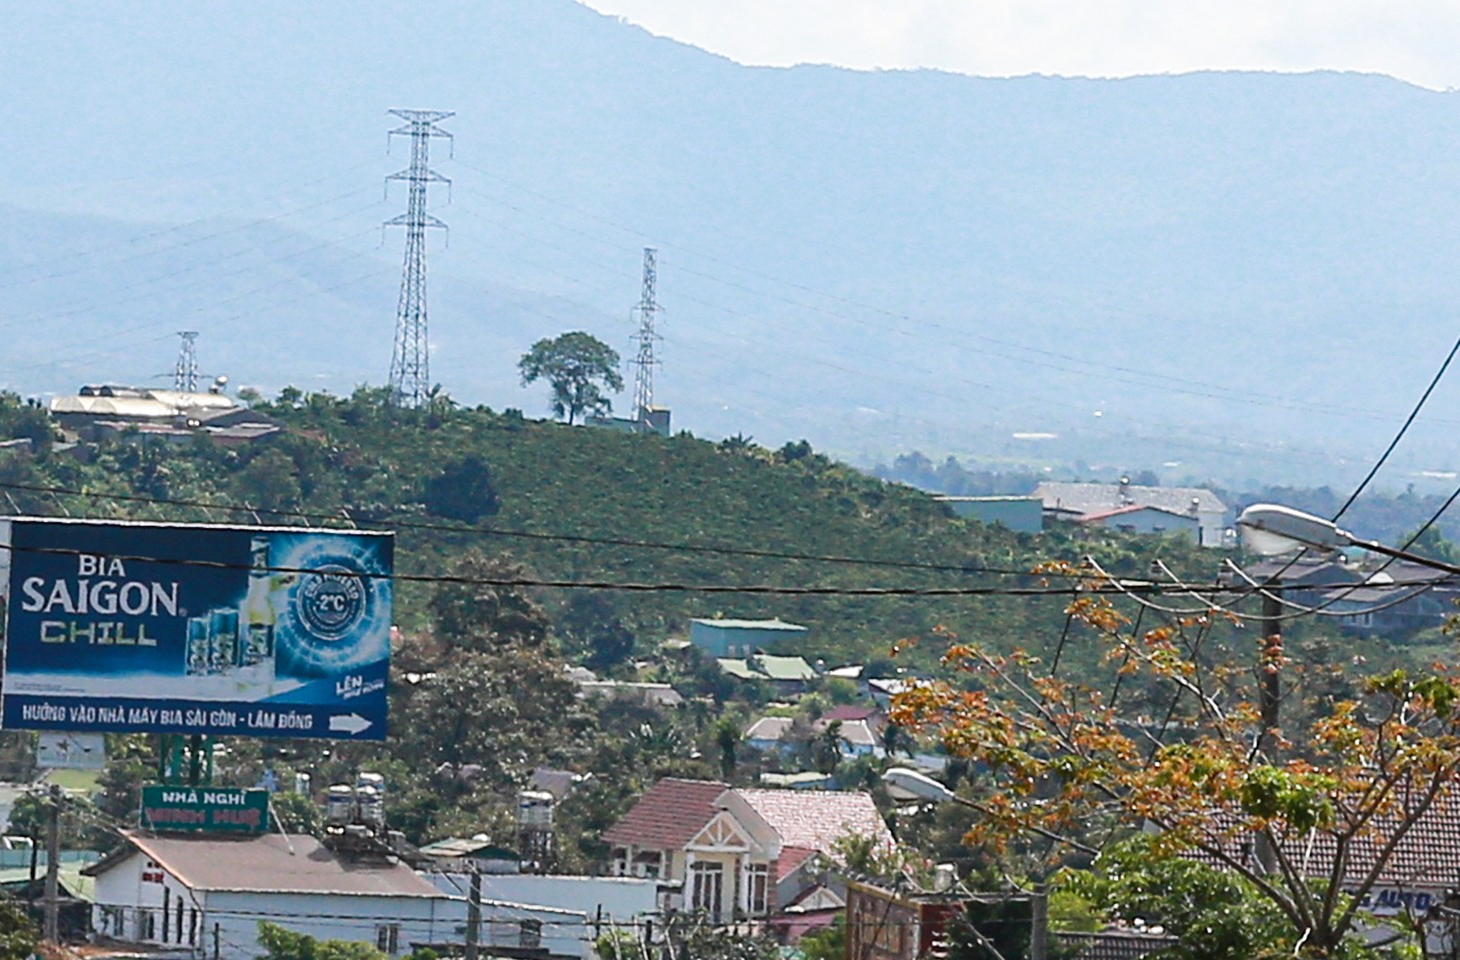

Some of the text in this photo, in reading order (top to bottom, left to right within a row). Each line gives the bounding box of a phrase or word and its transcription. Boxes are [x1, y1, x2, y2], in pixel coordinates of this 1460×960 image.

[78, 554, 125, 577] BIA
[22, 577, 179, 617] SAIGON
[40, 620, 157, 647] CHILL
[69, 704, 95, 723] VÀO
[99, 705, 125, 724] NHÀ
[128, 706, 158, 725] MÁY
[161, 709, 183, 726] BIA
[186, 709, 207, 727] SÀI
[210, 711, 236, 728] GÒN
[162, 789, 198, 804] NHÀ
